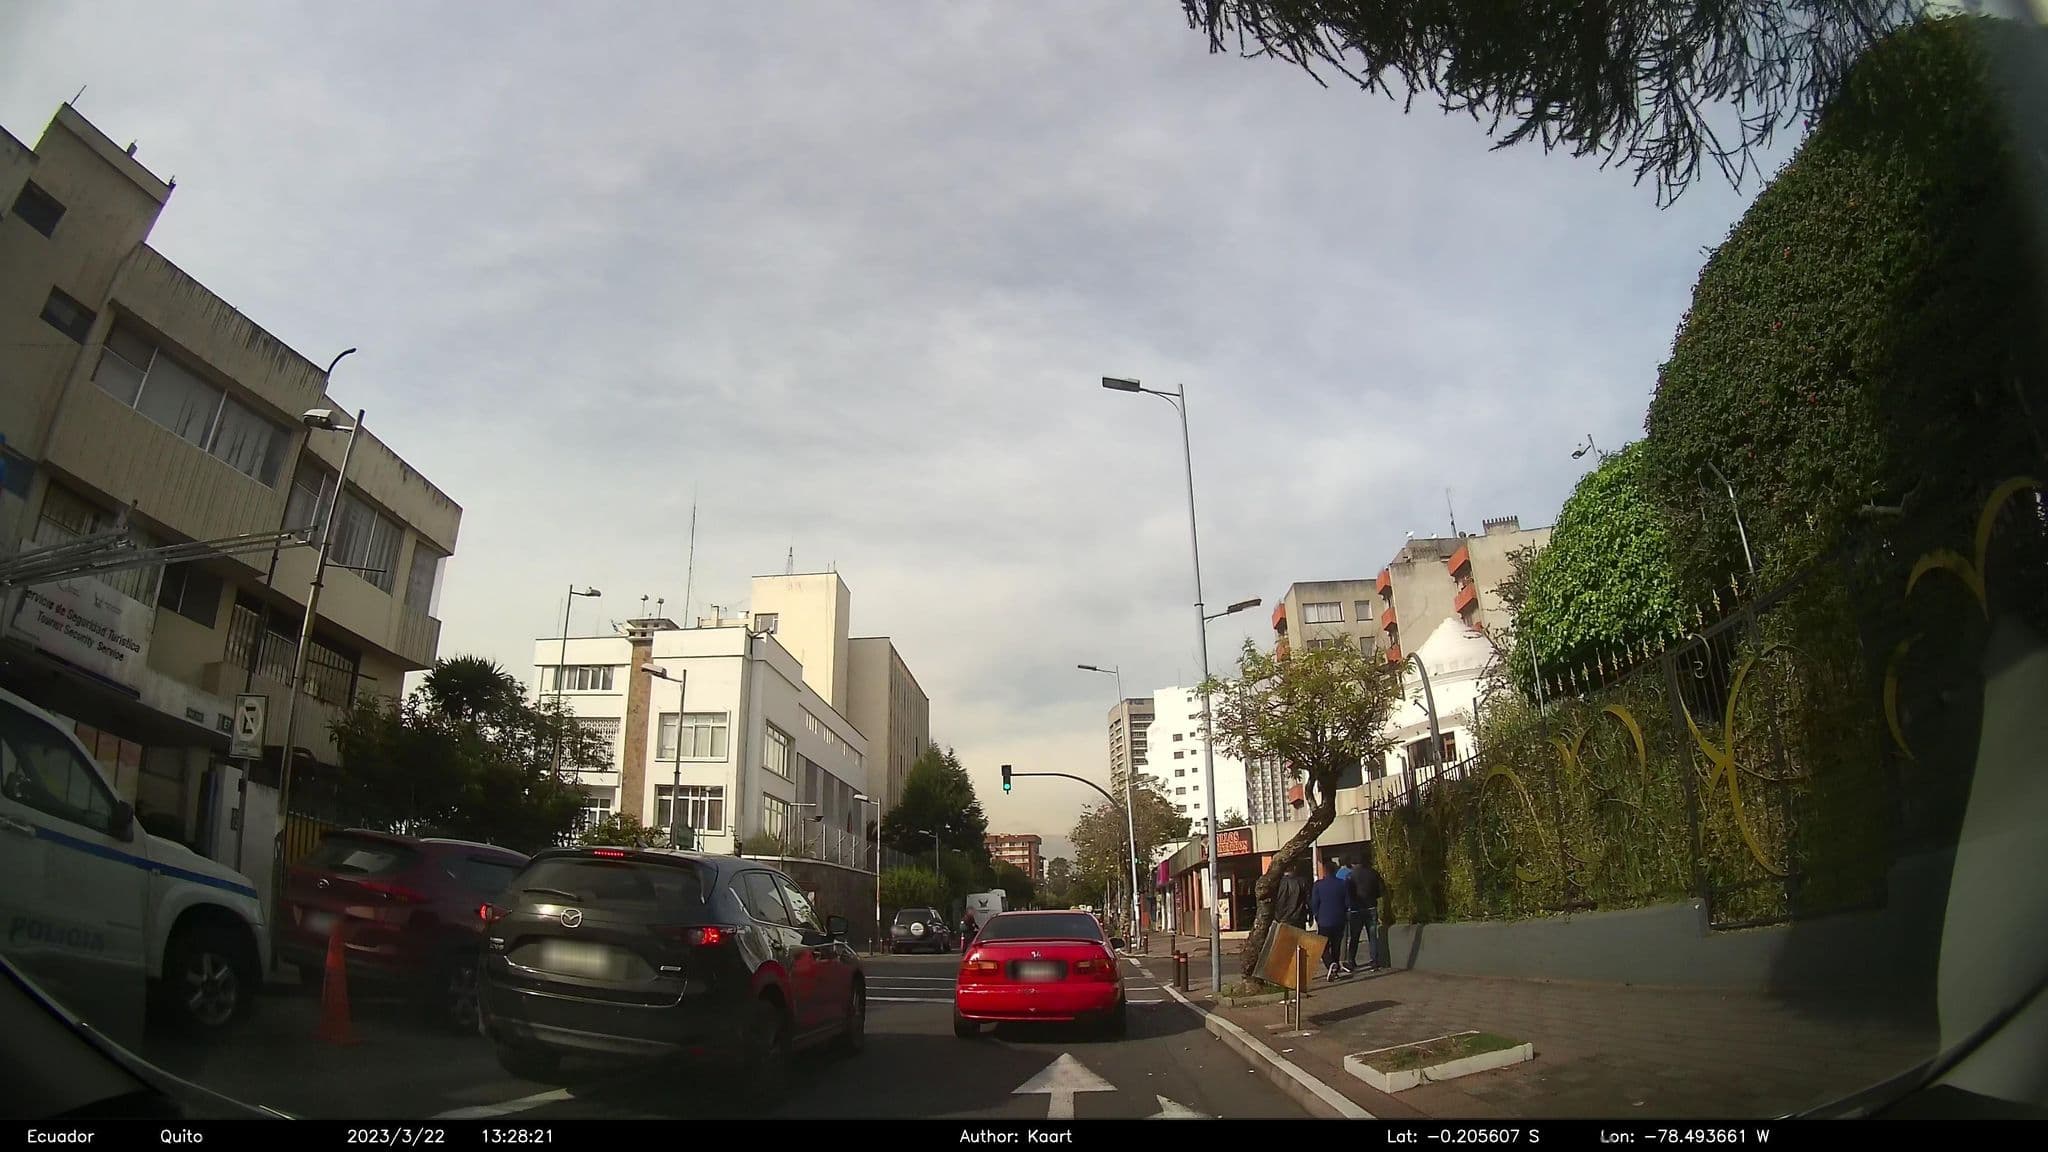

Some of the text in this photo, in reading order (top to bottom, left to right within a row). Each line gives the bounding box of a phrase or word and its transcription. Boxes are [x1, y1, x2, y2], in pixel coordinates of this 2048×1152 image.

[37, 610, 125, 662] Tourist Security Service
[55, 603, 66, 617] de
[66, 608, 108, 637] Seguridad
